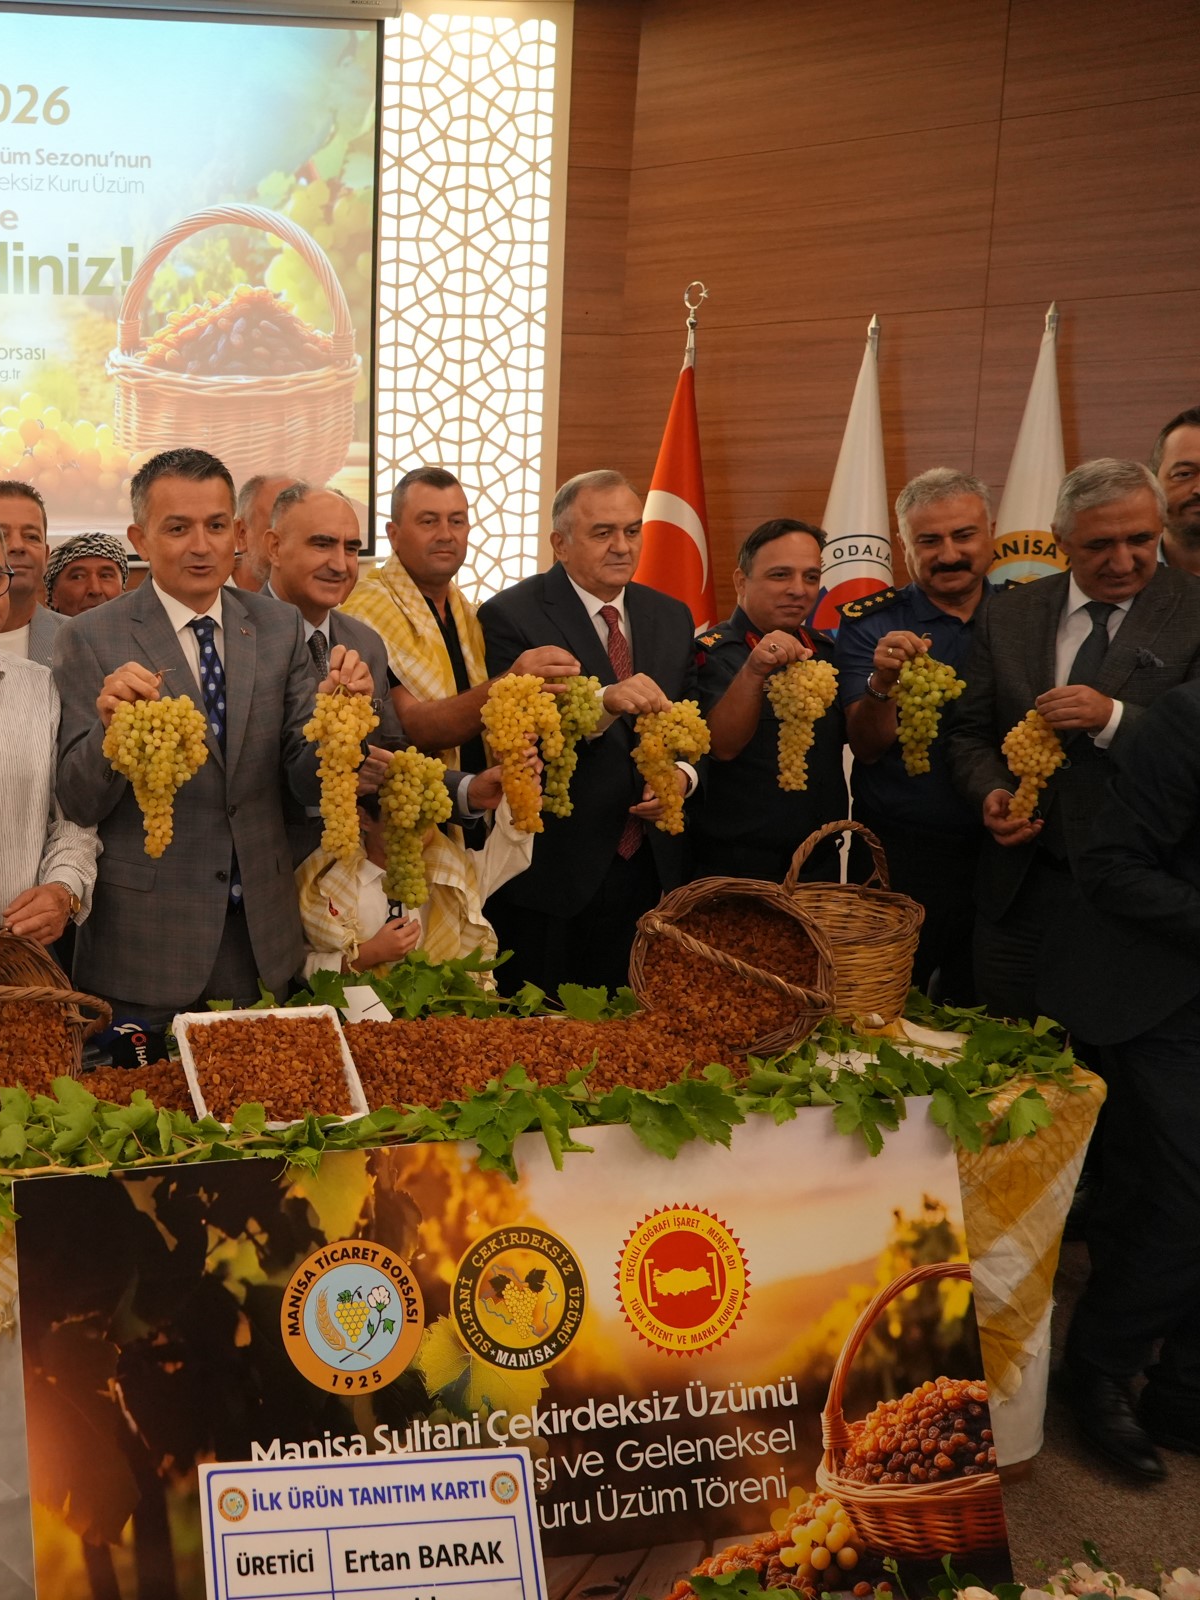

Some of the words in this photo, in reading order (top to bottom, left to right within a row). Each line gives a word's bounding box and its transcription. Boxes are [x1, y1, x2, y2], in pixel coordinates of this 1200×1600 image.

[48, 174, 88, 192] Kuru
[92, 172, 145, 194] Üzüm
[992, 534, 1057, 561] ANİSA
[471, 1231, 574, 1277] ÇEKİRDEKSİZ
[626, 1245, 642, 1283] TESCİLLİ
[638, 1216, 671, 1246] COĞRAFİ
[673, 1214, 701, 1229] İŞARET
[706, 1226, 730, 1253] MENŞE
[725, 1254, 737, 1270] ADI
[288, 1269, 316, 1337] MANİSA
[314, 1246, 380, 1270] TİCARET
[380, 1256, 419, 1324] BORSASI
[458, 1276, 492, 1353] SULTANİ
[556, 1285, 583, 1345] ÜZÜMÜ
[629, 1297, 647, 1322] TÜRK
[644, 1320, 674, 1343] PATENT
[677, 1335, 687, 1345] VE
[690, 1324, 719, 1344] MARKA
[717, 1288, 740, 1327] KURUMU
[331, 1370, 382, 1389] 1925
[494, 1344, 555, 1367] MANİSA
[373, 1411, 480, 1455] Sultani
[486, 1390, 680, 1448] Çekirdeksiz
[685, 1374, 799, 1419] Üzümü
[561, 1450, 605, 1479] ve
[615, 1420, 797, 1472] Geleneksel
[252, 1487, 283, 1512] İLK
[287, 1484, 344, 1510] ÜRÜN
[348, 1483, 426, 1506] TANITIM
[431, 1479, 487, 1502] KARTI
[538, 1499, 592, 1530] uru
[596, 1484, 688, 1522] Üzüm
[691, 1467, 788, 1509] Töreni
[236, 1548, 315, 1577] ÜRETİCİ
[344, 1549, 412, 1574] Ertan
[418, 1540, 505, 1570] BARAK
